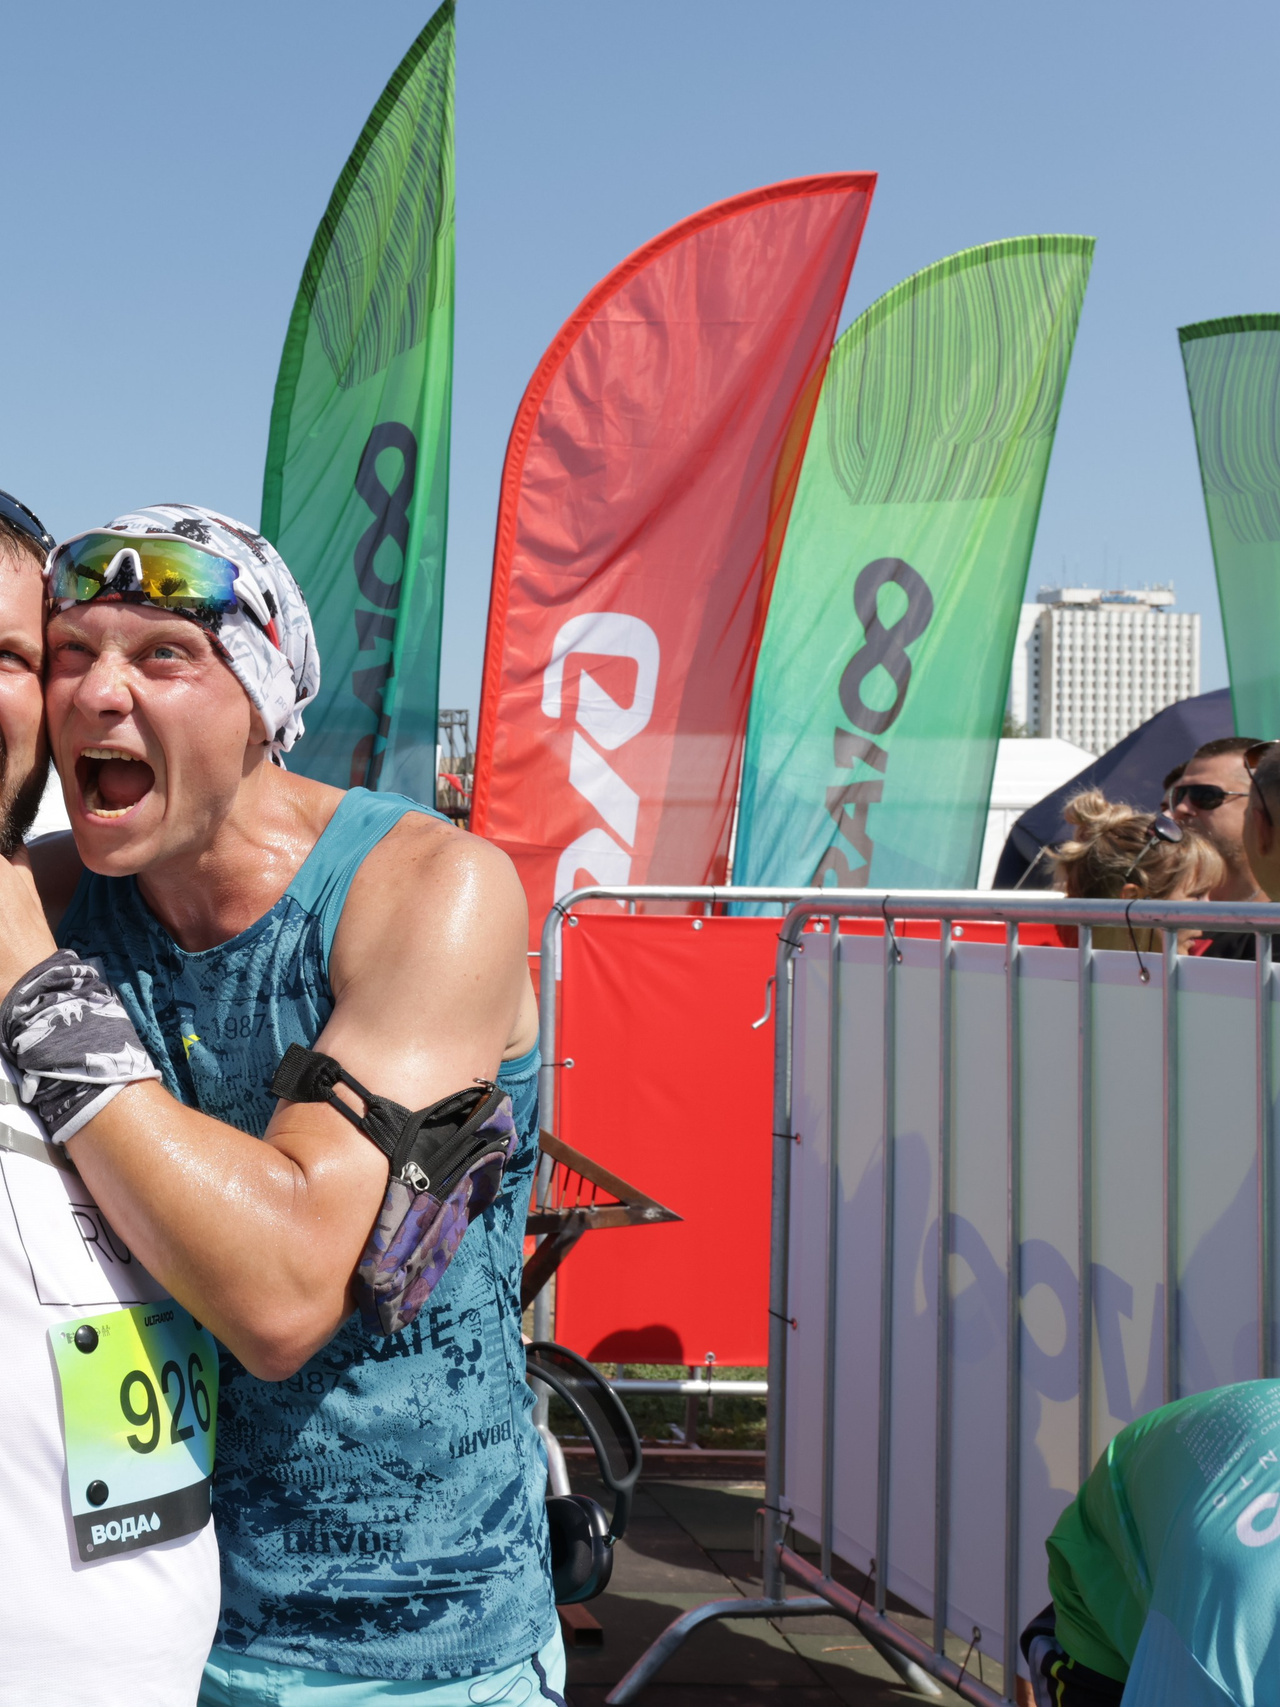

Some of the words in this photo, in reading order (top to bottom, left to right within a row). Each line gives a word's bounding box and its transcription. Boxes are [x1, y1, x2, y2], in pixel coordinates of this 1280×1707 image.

[71, 1210, 142, 1265] RU
[120, 1352, 211, 1454] 926
[91, 1514, 151, 1545] ВОДА
